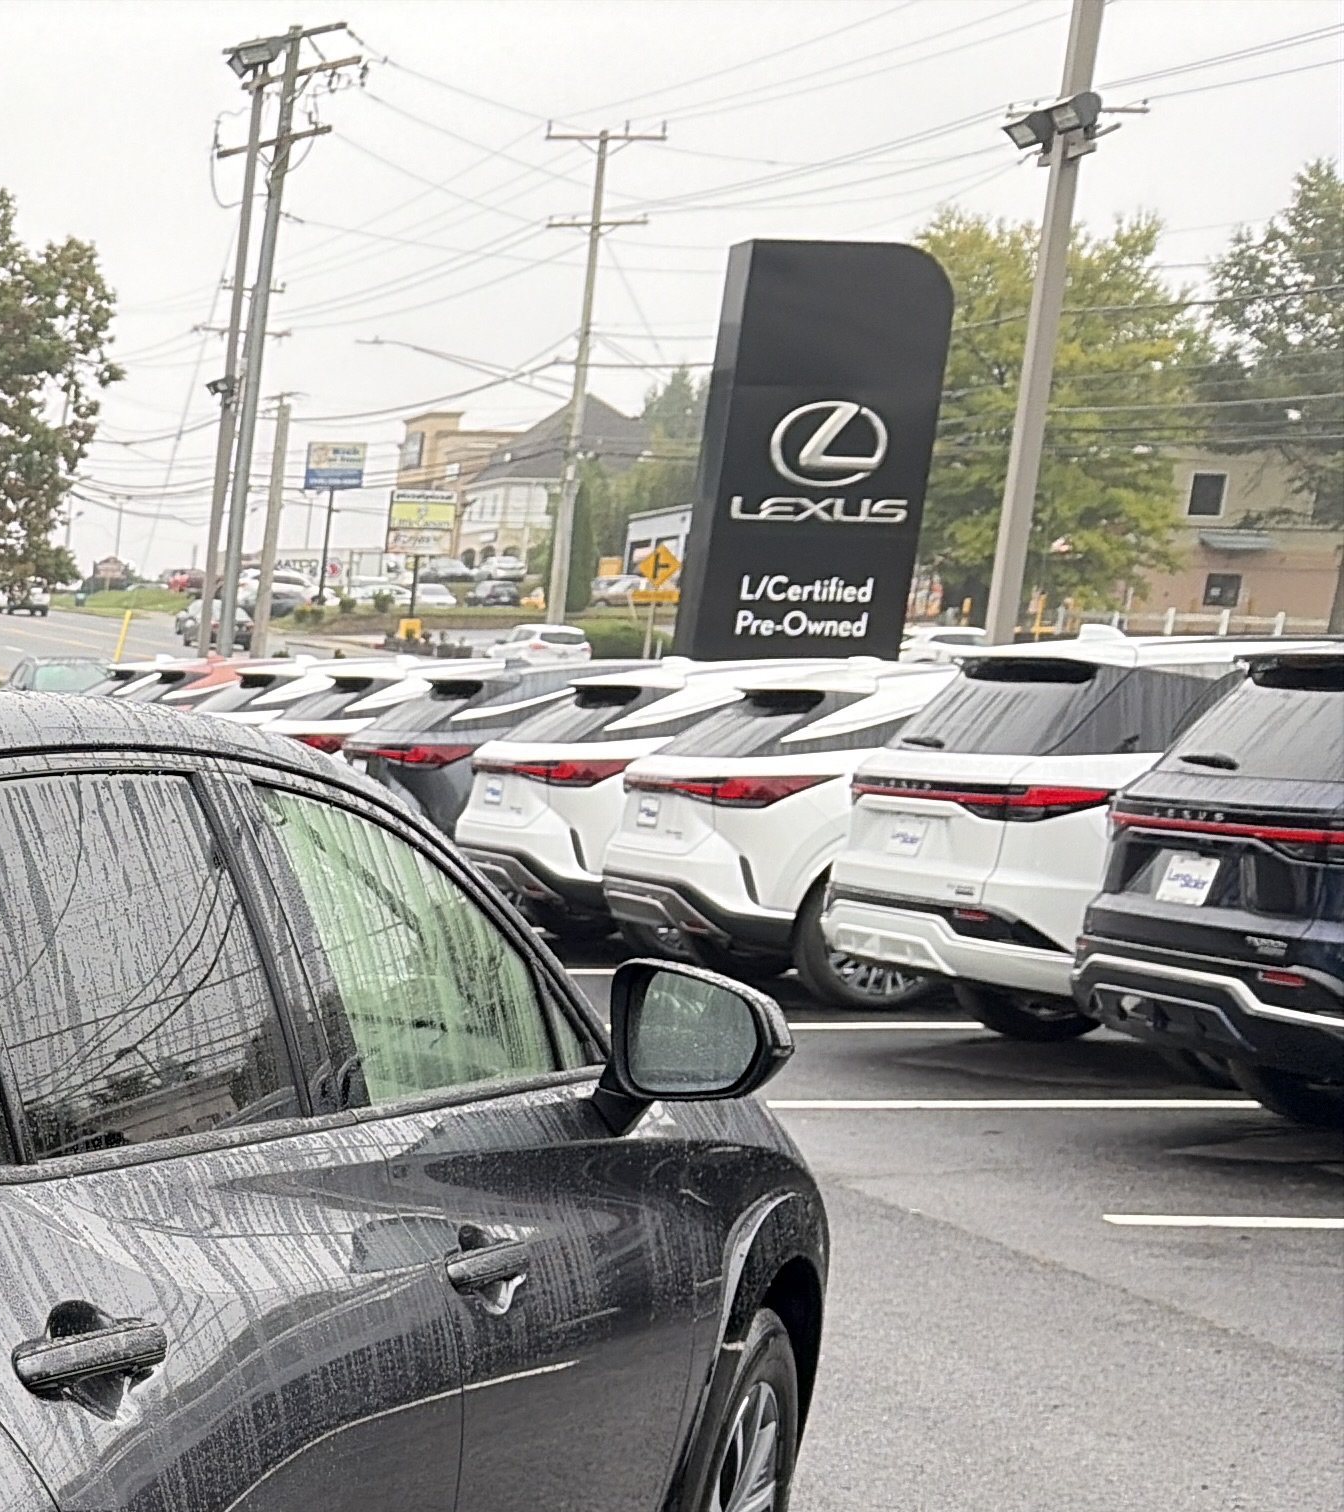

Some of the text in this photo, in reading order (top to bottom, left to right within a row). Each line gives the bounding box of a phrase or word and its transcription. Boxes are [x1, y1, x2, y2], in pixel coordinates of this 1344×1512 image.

[730, 496, 908, 523] LEXUS
[740, 575, 874, 603] L/Certified
[734, 609, 869, 638] Pre-Owned
